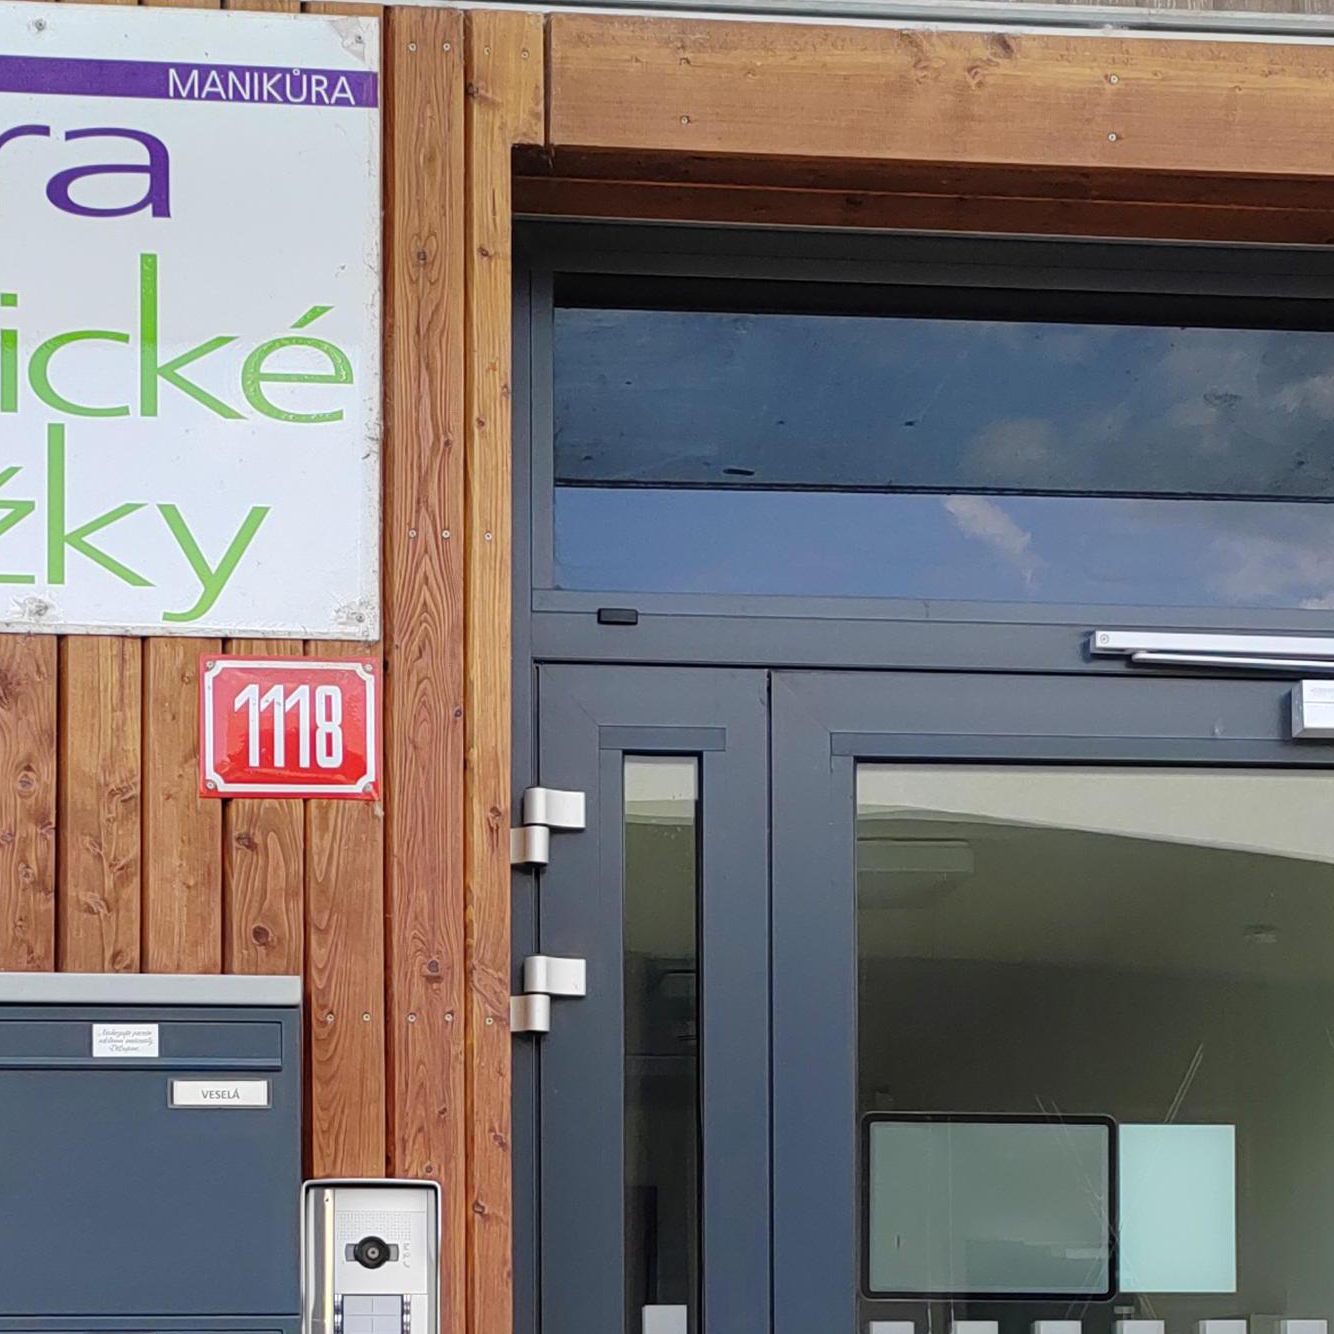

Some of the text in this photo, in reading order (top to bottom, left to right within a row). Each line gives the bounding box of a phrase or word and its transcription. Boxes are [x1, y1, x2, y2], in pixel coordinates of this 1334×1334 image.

[168, 67, 356, 105] MANIKŮRA
[234, 684, 343, 768] 1118
[201, 1088, 240, 1099] VESELÁ
